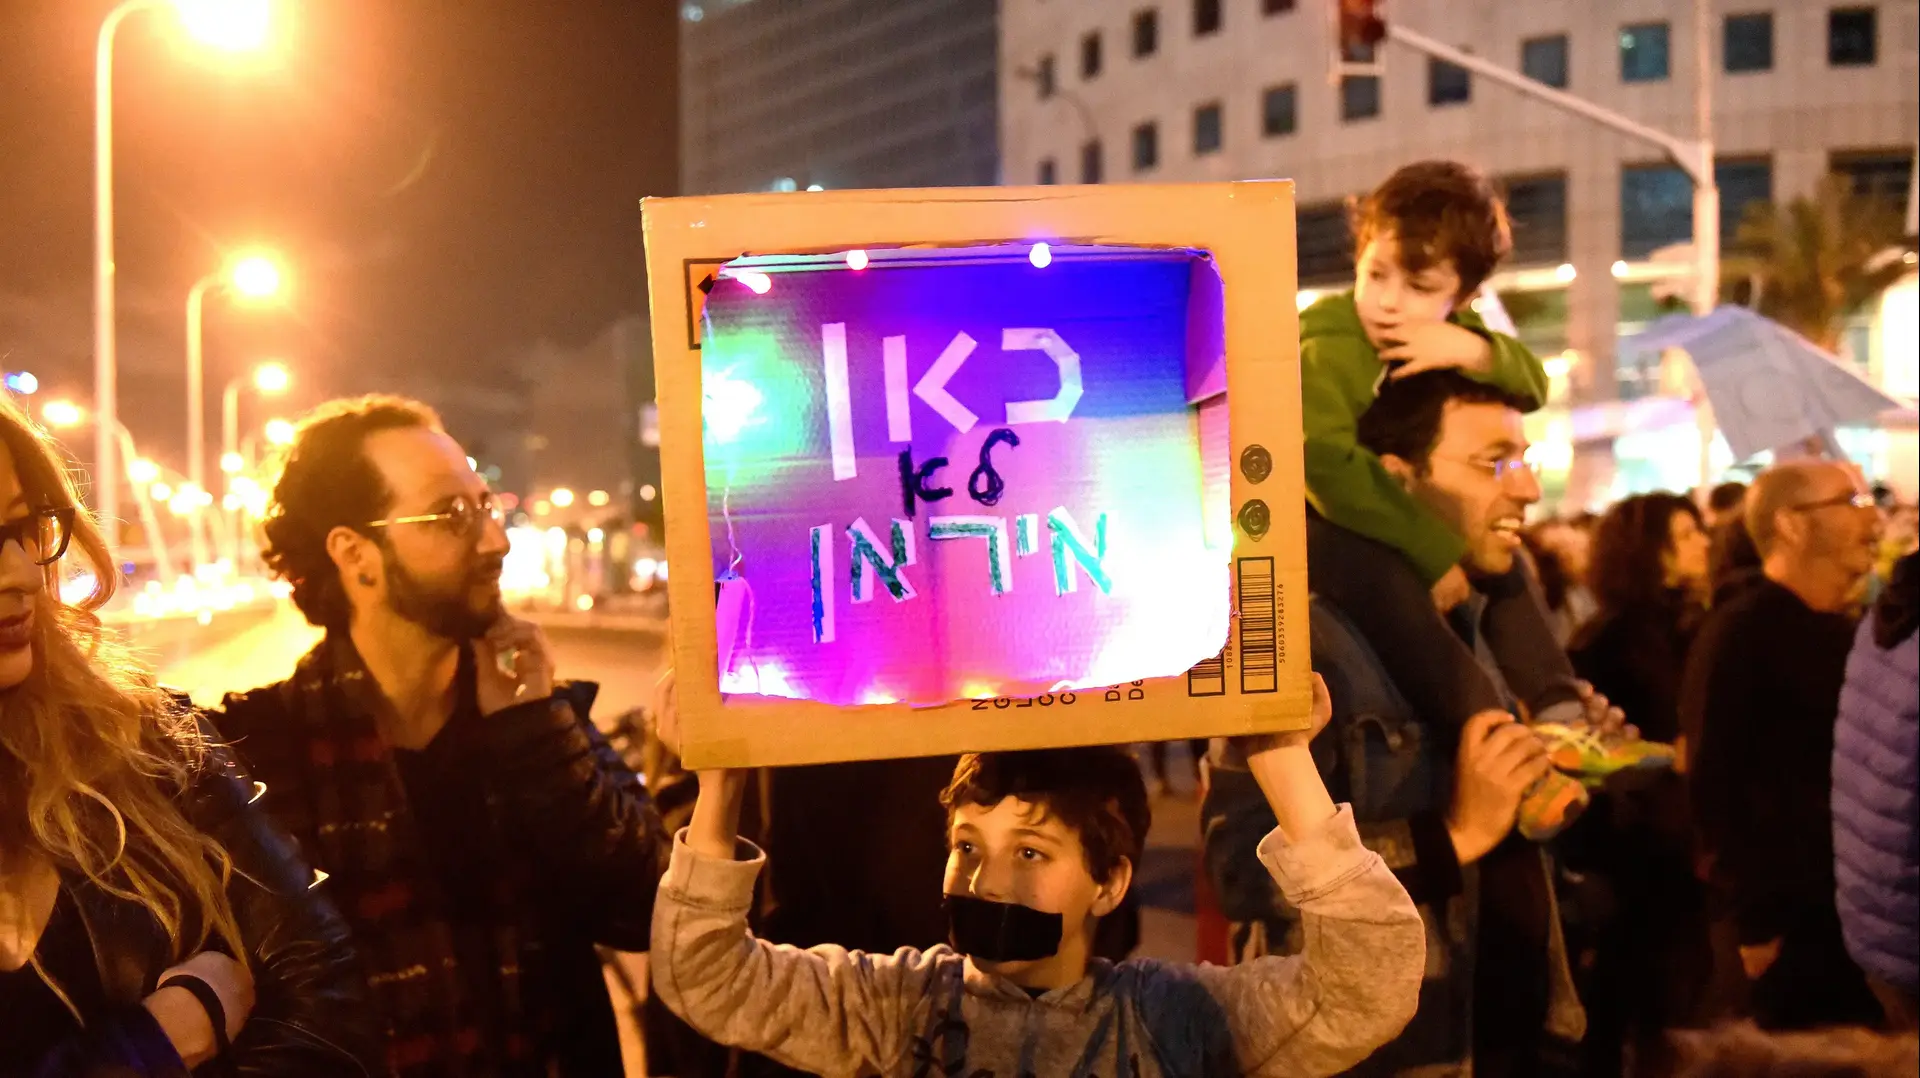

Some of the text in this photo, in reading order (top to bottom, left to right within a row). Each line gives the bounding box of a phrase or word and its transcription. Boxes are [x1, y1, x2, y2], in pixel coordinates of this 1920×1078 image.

[822, 322, 1084, 481] כאן
[899, 428, 1020, 517] לא
[810, 506, 1112, 644] איראן
